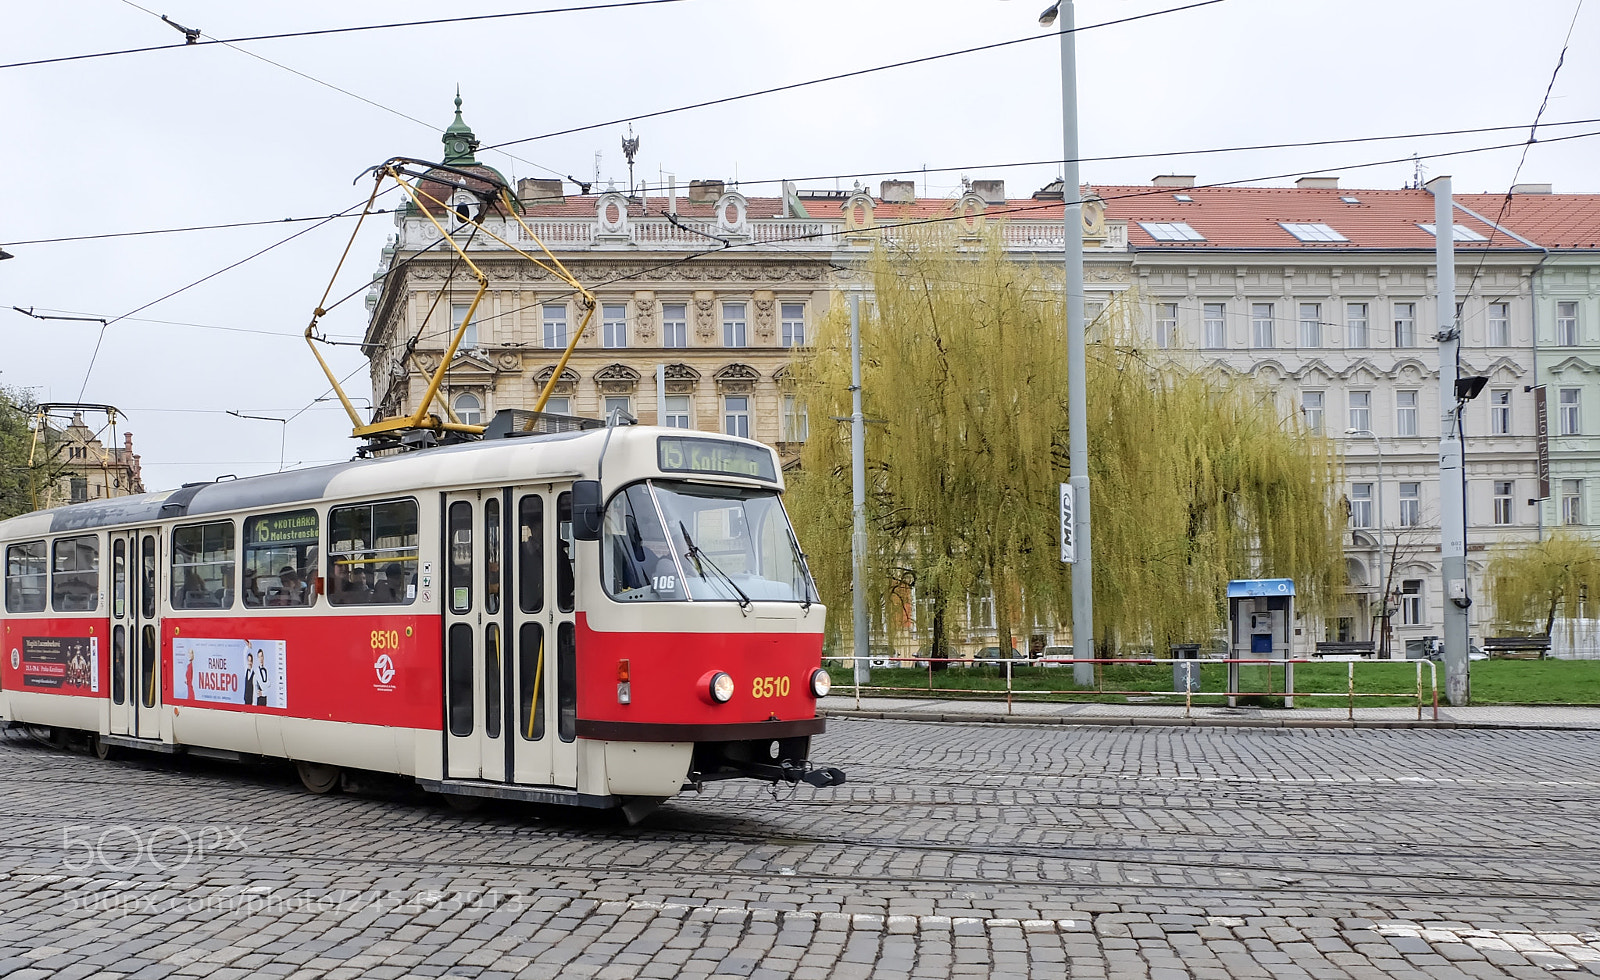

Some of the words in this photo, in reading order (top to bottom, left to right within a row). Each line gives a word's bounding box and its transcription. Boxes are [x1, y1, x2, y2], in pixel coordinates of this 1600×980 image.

[660, 441, 683, 469] 15
[1063, 493, 1072, 546] MND
[255, 519, 270, 542] 15
[652, 575, 675, 590] 106
[370, 630, 399, 649] 8510
[208, 657, 227, 671] RANDE
[198, 671, 238, 692] NASLEPO
[752, 676, 790, 698] 8510
